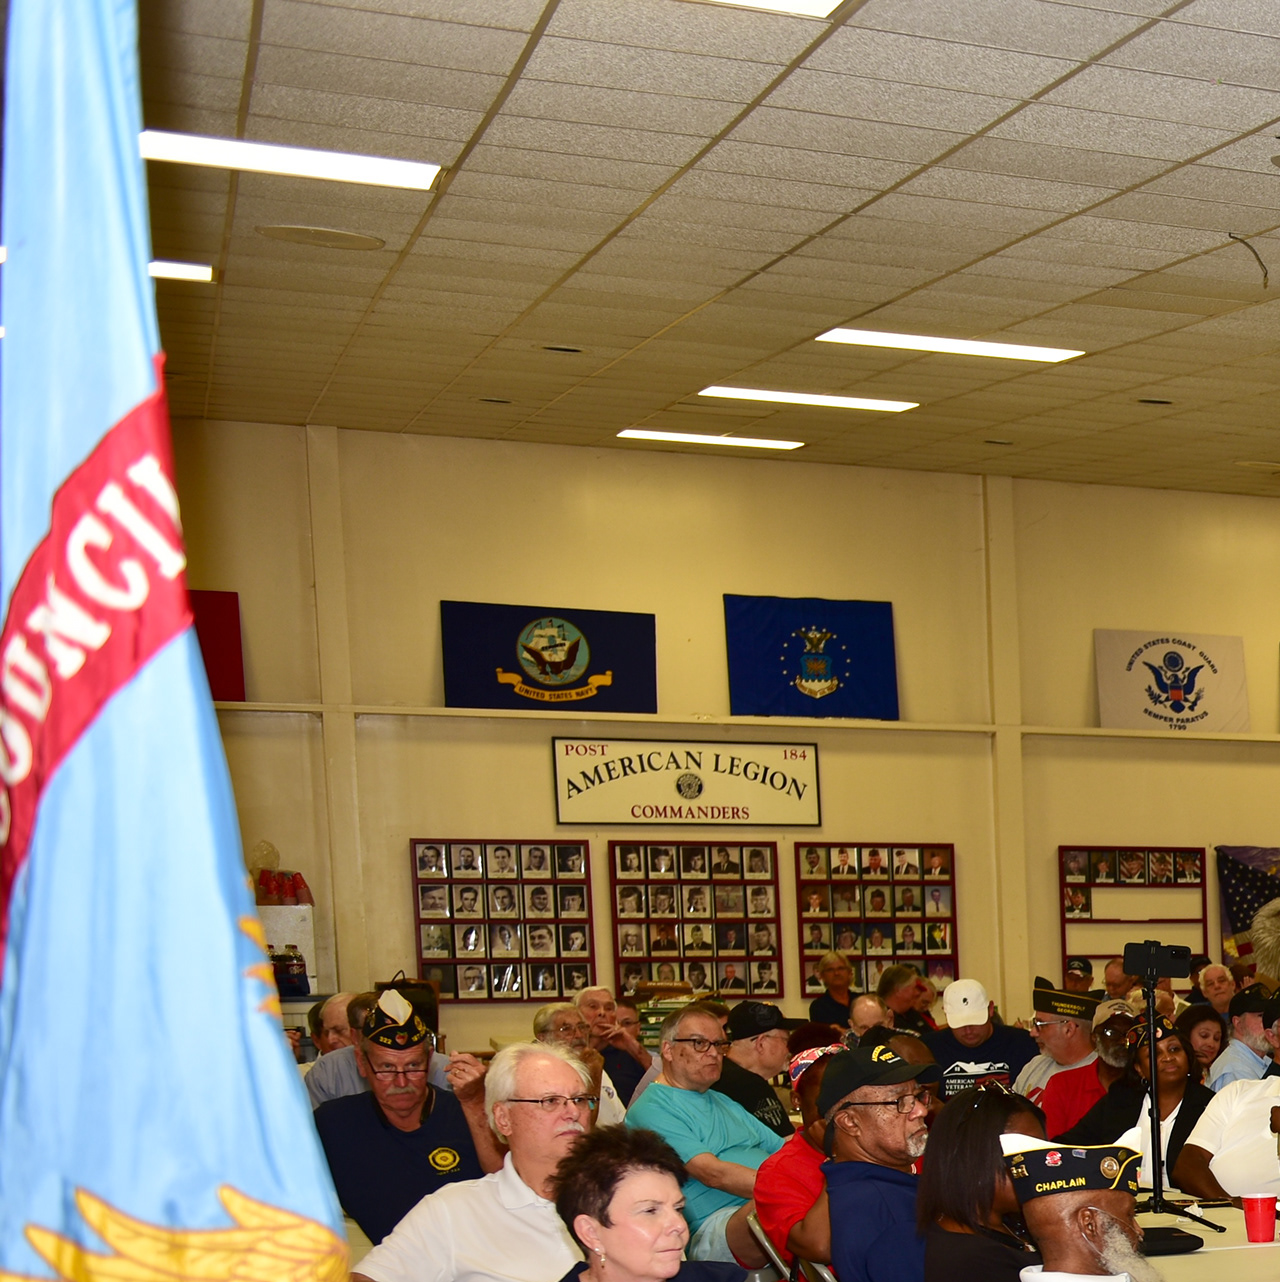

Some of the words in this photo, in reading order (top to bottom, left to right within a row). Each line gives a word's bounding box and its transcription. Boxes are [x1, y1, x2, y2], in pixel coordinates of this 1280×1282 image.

[1125, 647, 1144, 672] UNITED
[1143, 638, 1170, 650] STATES
[1171, 638, 1196, 651] COAST
[1198, 651, 1218, 675] GUARD
[518, 685, 546, 699] UNITED
[548, 692, 573, 700] STATES
[575, 687, 595, 698] NAVY
[1143, 708, 1174, 723] SEMPER
[1175, 710, 1209, 723] PARATUS
[564, 743, 609, 756] POST
[782, 749, 807, 761] 184
[567, 751, 703, 799] AMERICAN
[713, 752, 808, 801] LEGION
[630, 804, 750, 820] COMMANDERS
[1051, 1001, 1086, 1011] THUNDERBOLT
[1056, 1007, 1079, 1015] GEORGIA
[1035, 1177, 1086, 1192] CHAPLAIN
